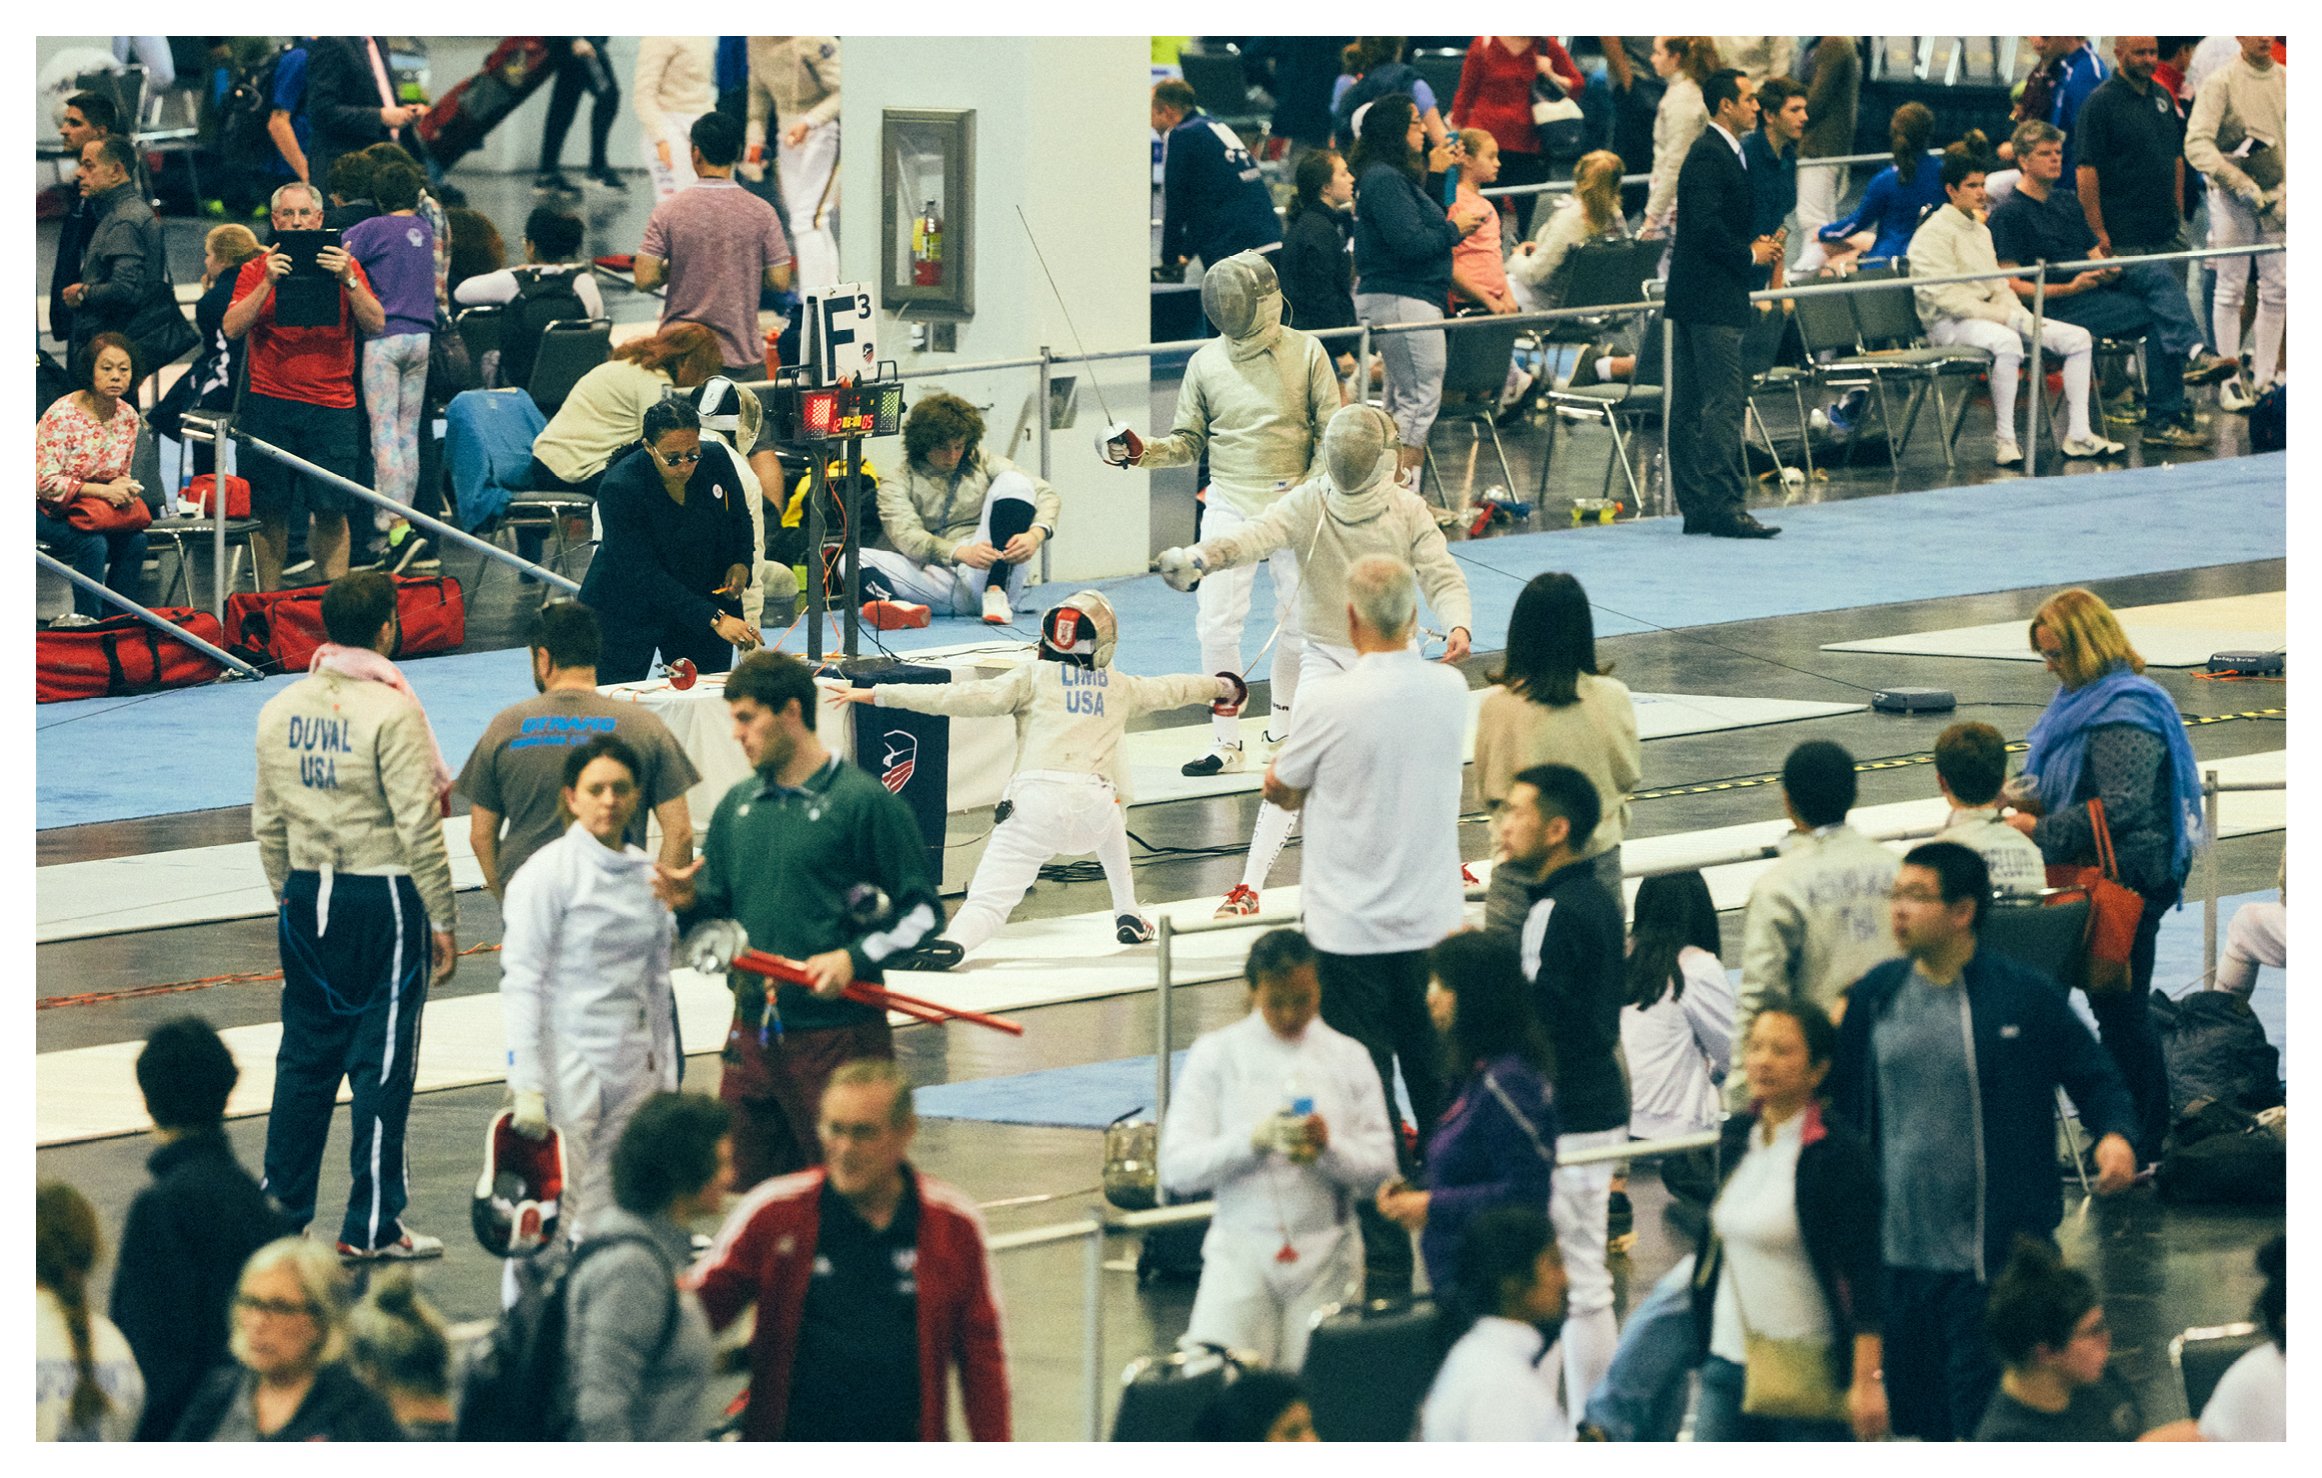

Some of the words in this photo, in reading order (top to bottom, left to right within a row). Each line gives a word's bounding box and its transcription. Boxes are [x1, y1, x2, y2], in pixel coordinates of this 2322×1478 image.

[862, 414, 874, 430] 05
[1066, 690, 1105, 718] USA
[289, 715, 352, 753] DUVAL
[301, 755, 339, 790] USA
